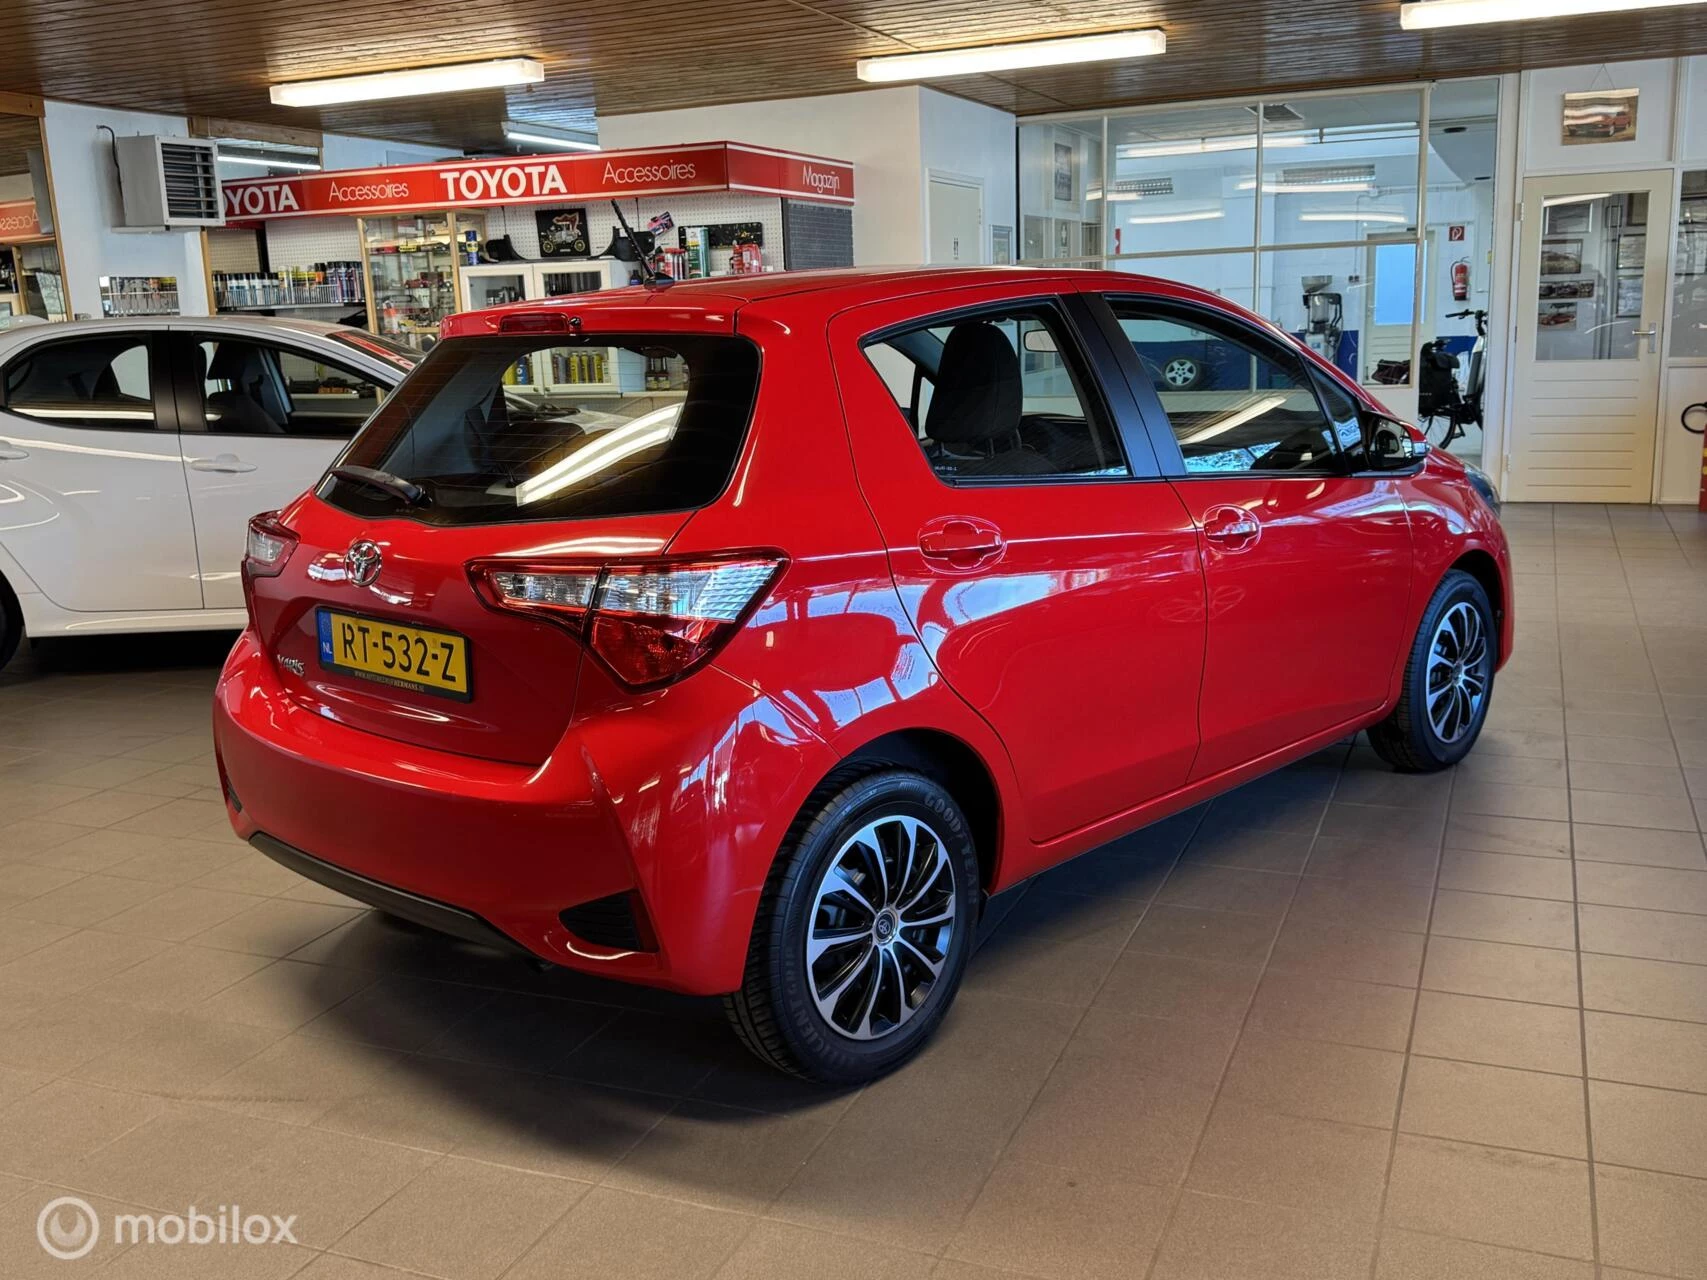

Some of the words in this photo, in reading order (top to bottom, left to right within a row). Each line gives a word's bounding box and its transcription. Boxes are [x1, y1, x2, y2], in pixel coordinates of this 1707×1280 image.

[440, 164, 567, 200] TOYOTA
[602, 159, 696, 184] Accessoires
[803, 162, 840, 195] Magazijn
[329, 180, 409, 202] Accessoires
[342, 622, 456, 682] RT-532-Z
